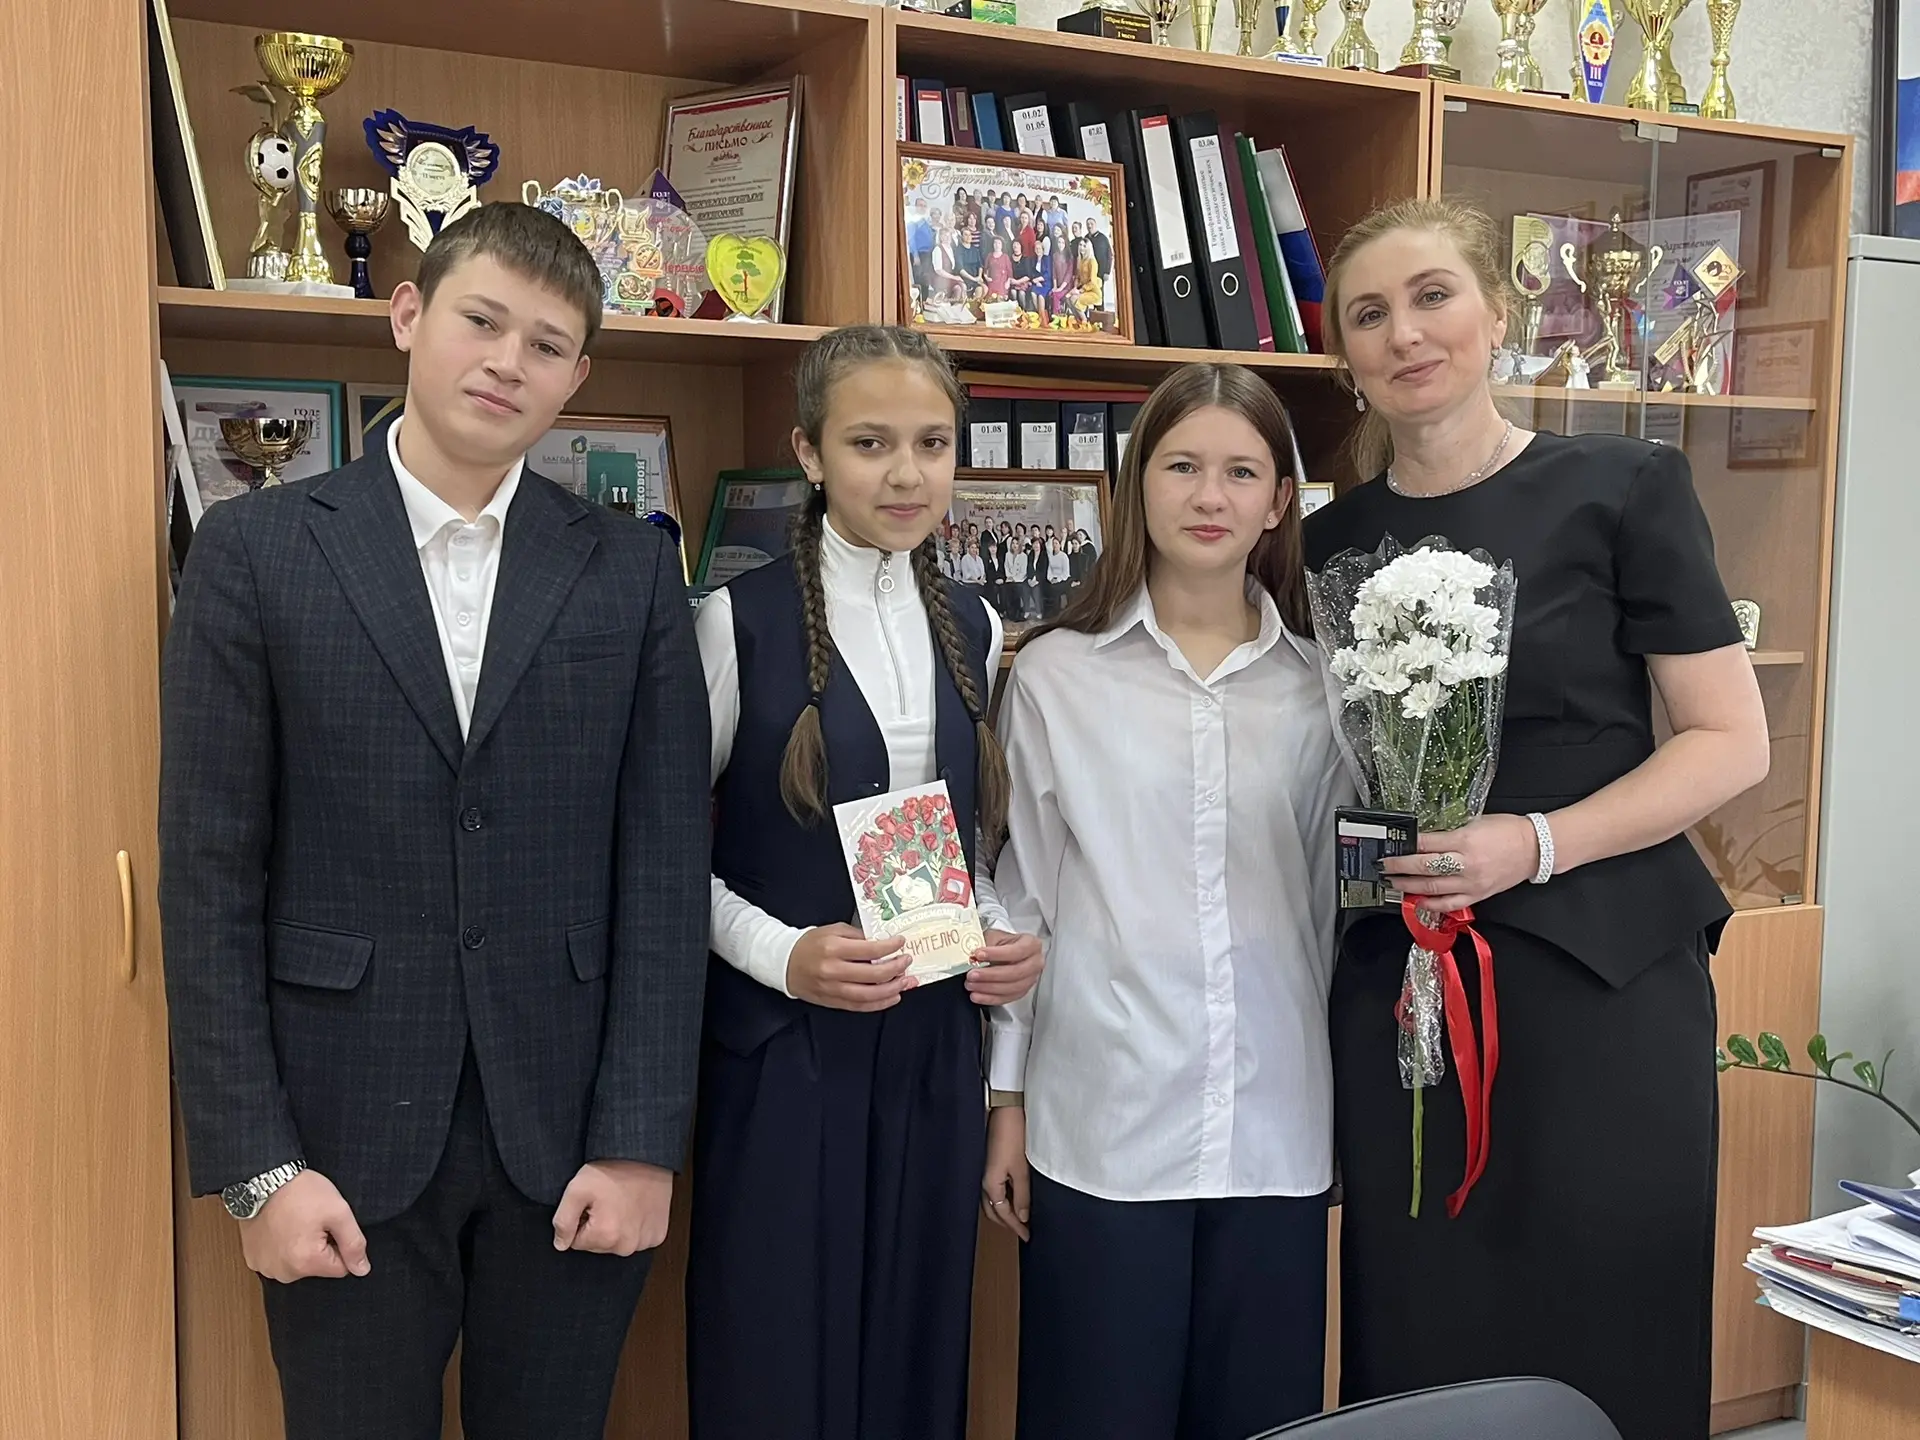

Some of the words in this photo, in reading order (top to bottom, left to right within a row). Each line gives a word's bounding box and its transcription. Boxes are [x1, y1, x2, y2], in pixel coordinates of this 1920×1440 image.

[1022, 108, 1044, 120] 01.02/
[688, 118, 773, 142] Благодарственное
[1025, 121, 1046, 132] 01.05
[981, 425, 1002, 434] 01.08
[1032, 425, 1052, 433] 02.20
[1078, 435, 1098, 444] 01.07
